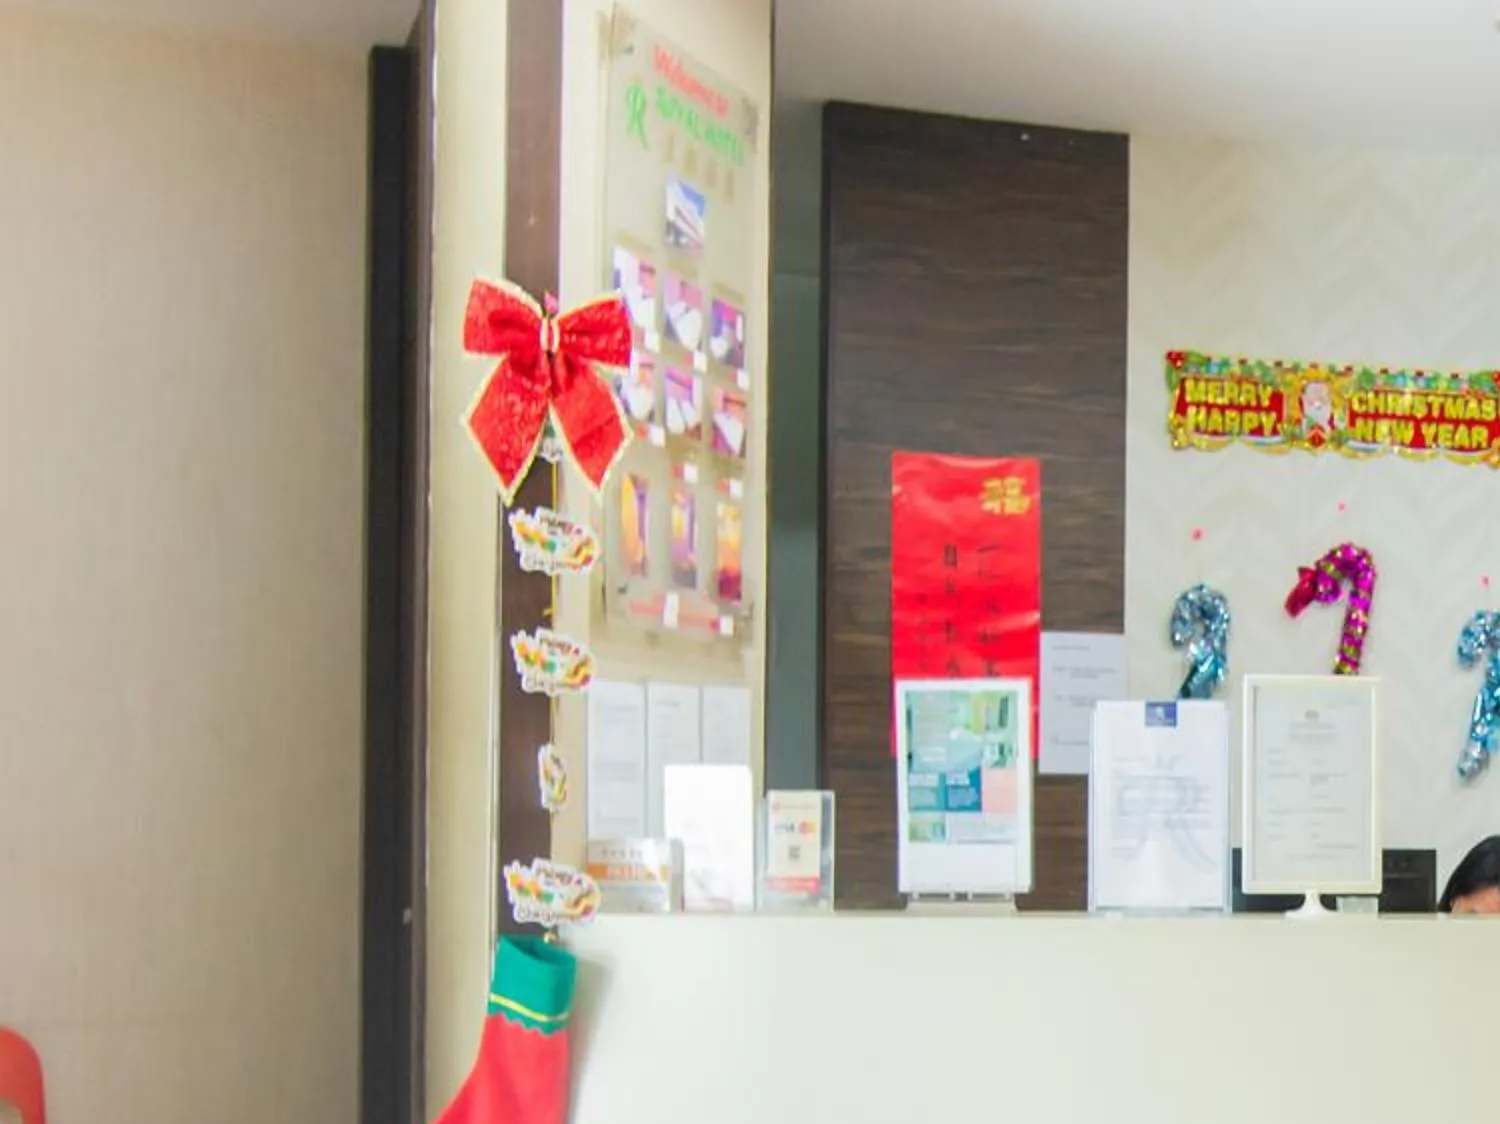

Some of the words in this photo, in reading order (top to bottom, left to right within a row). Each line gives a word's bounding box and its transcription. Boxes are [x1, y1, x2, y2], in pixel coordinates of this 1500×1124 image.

[1185, 377, 1273, 407] MERRY
[1351, 392, 1497, 421] CHRISTMAS
[1186, 406, 1278, 436] HAPPY
[1355, 418, 1415, 443] NEW
[1421, 422, 1490, 449] YEAR
